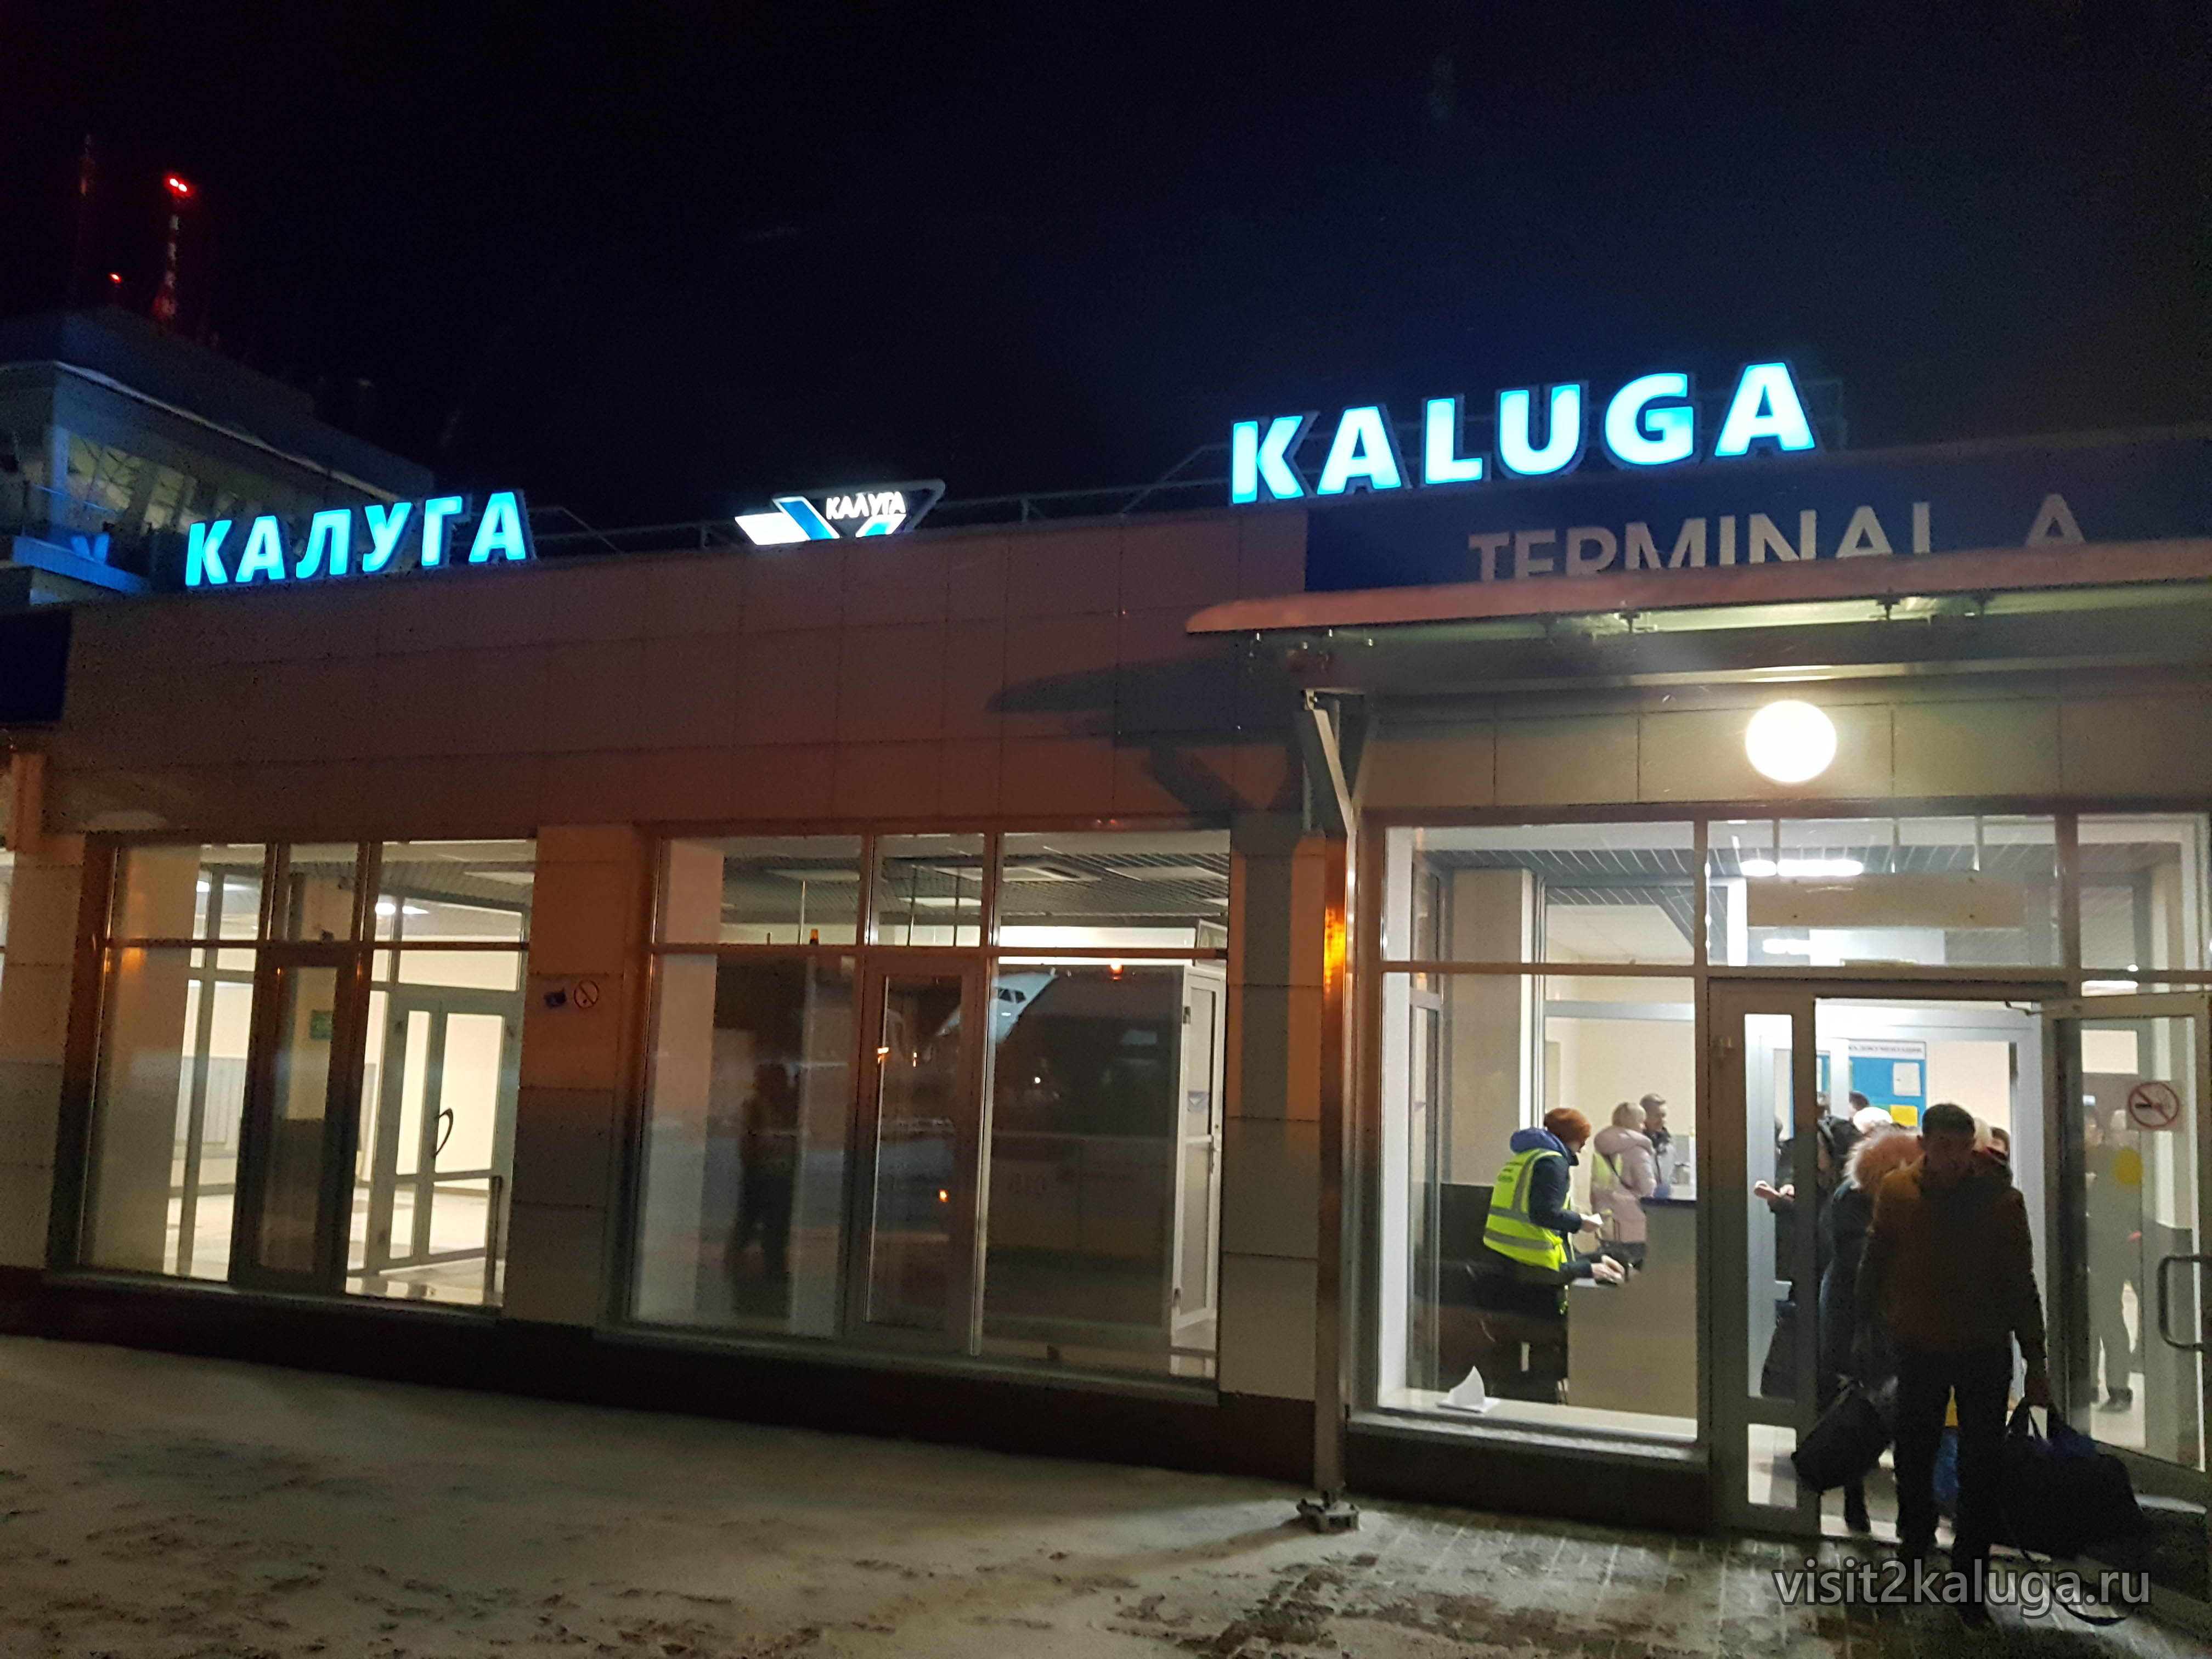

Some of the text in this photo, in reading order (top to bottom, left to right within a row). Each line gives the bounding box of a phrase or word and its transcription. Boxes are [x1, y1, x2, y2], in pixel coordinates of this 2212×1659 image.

[1232, 362, 1815, 504] KALUGA
[184, 491, 527, 587] КАЛУГА
[826, 491, 906, 520] КАЛУГА
[2024, 493, 2087, 548] A
